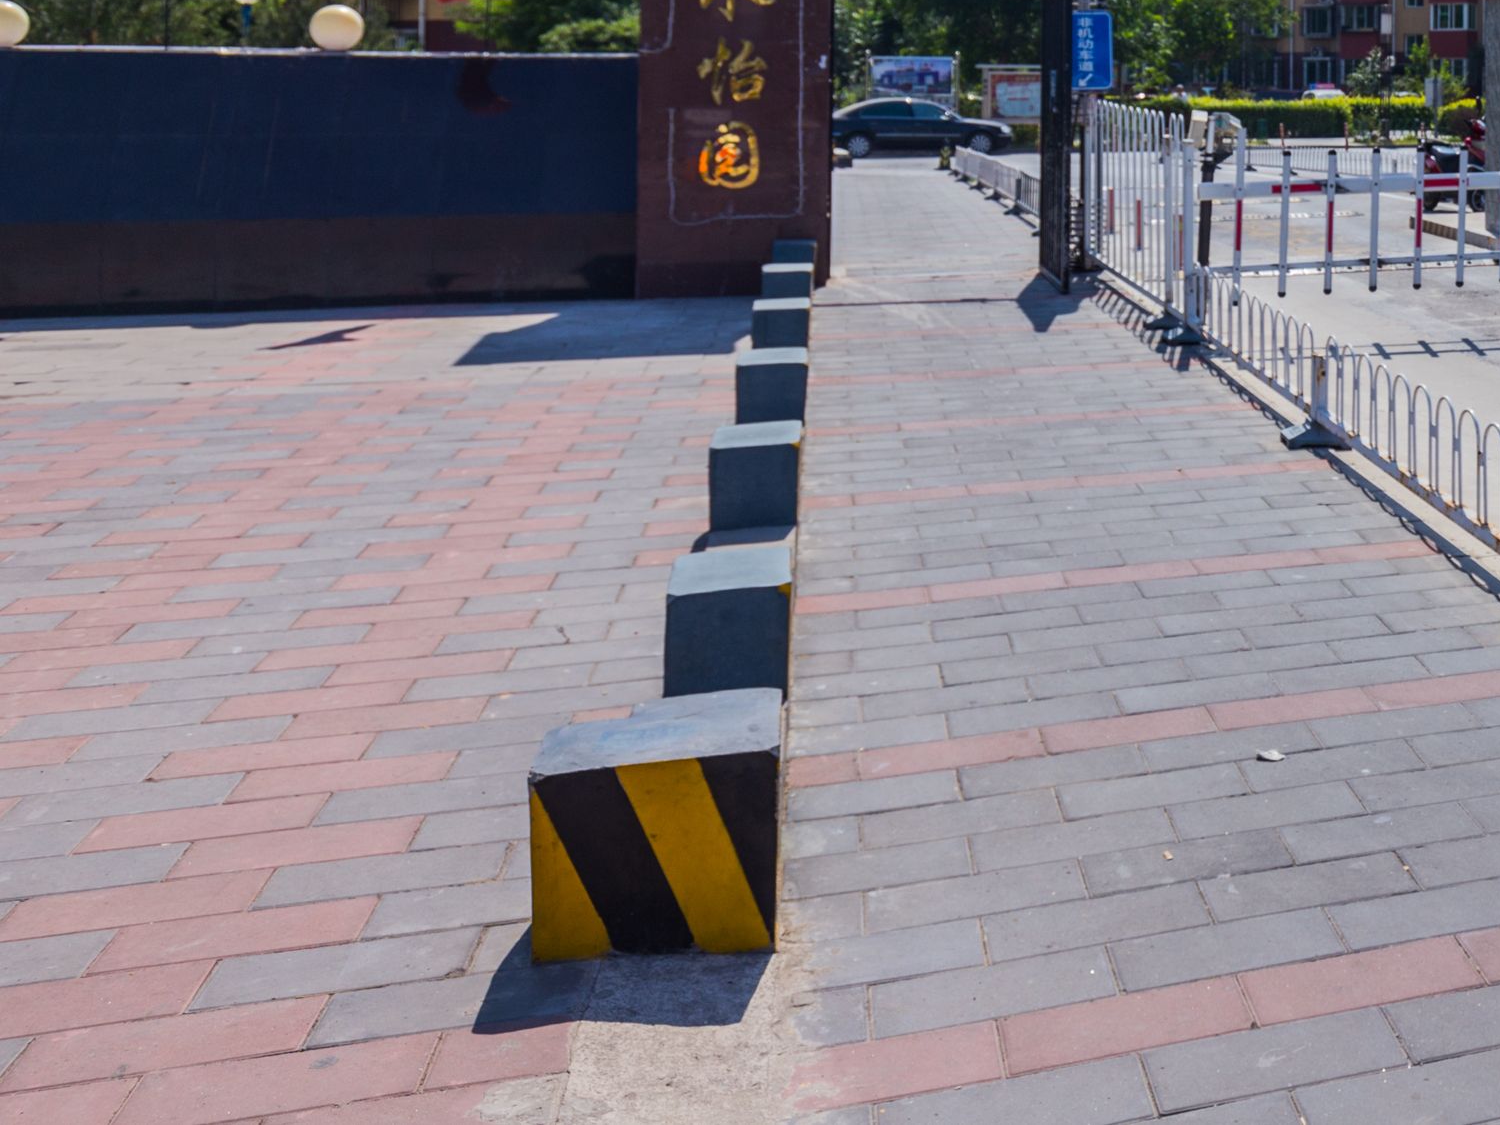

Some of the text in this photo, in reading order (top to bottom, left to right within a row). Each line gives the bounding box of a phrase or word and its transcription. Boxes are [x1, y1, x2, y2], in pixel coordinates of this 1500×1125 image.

[1078, 17, 1095, 72] 非机动车道
